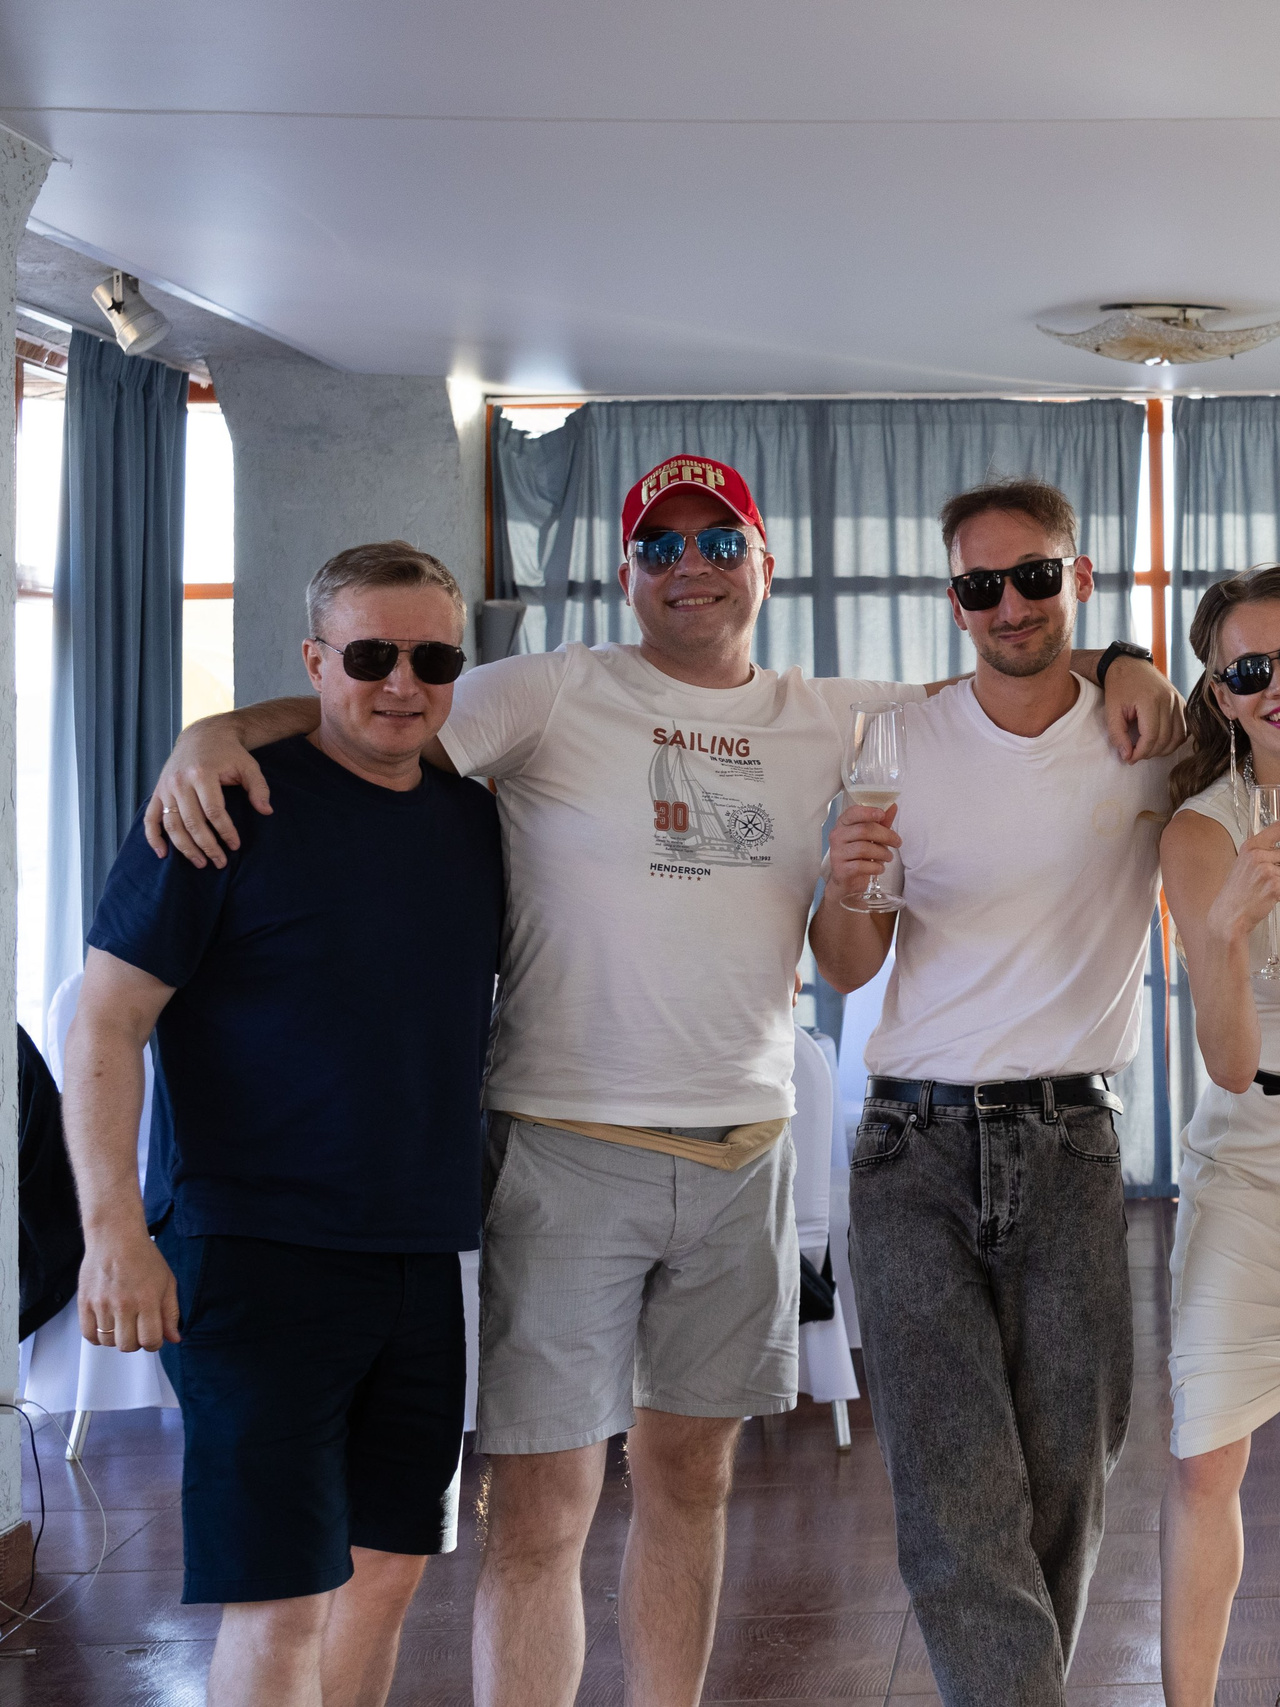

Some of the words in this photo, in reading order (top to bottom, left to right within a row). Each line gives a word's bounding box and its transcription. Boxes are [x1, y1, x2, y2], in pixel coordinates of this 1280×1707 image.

[653, 728, 750, 757] SAILING
[654, 800, 689, 833] 30
[650, 862, 711, 876] HENDERSON
